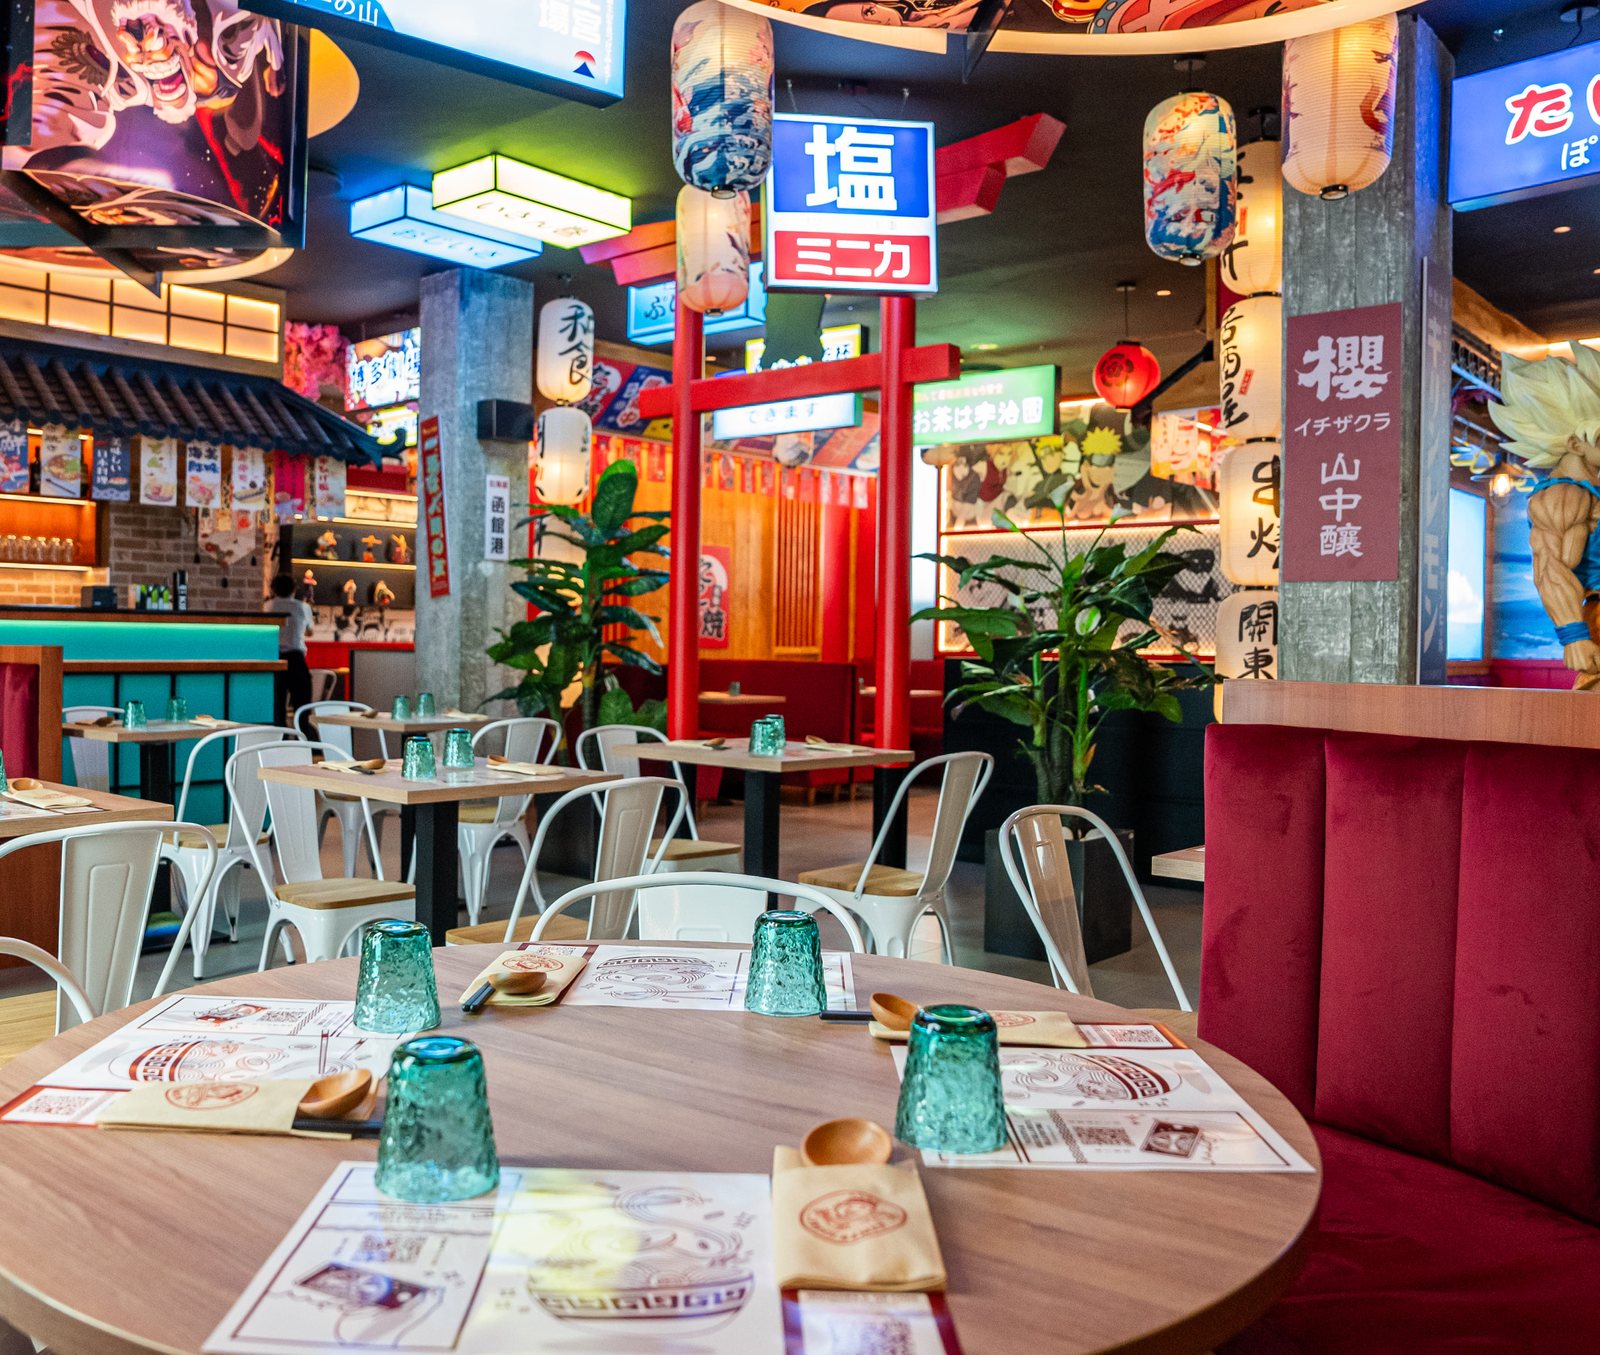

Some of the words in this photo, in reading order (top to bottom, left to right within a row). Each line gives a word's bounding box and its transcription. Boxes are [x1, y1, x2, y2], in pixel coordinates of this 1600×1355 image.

[804, 124, 898, 211] 塩
[795, 239, 911, 279] ミニカ
[1294, 412, 1391, 437] イチザクラ
